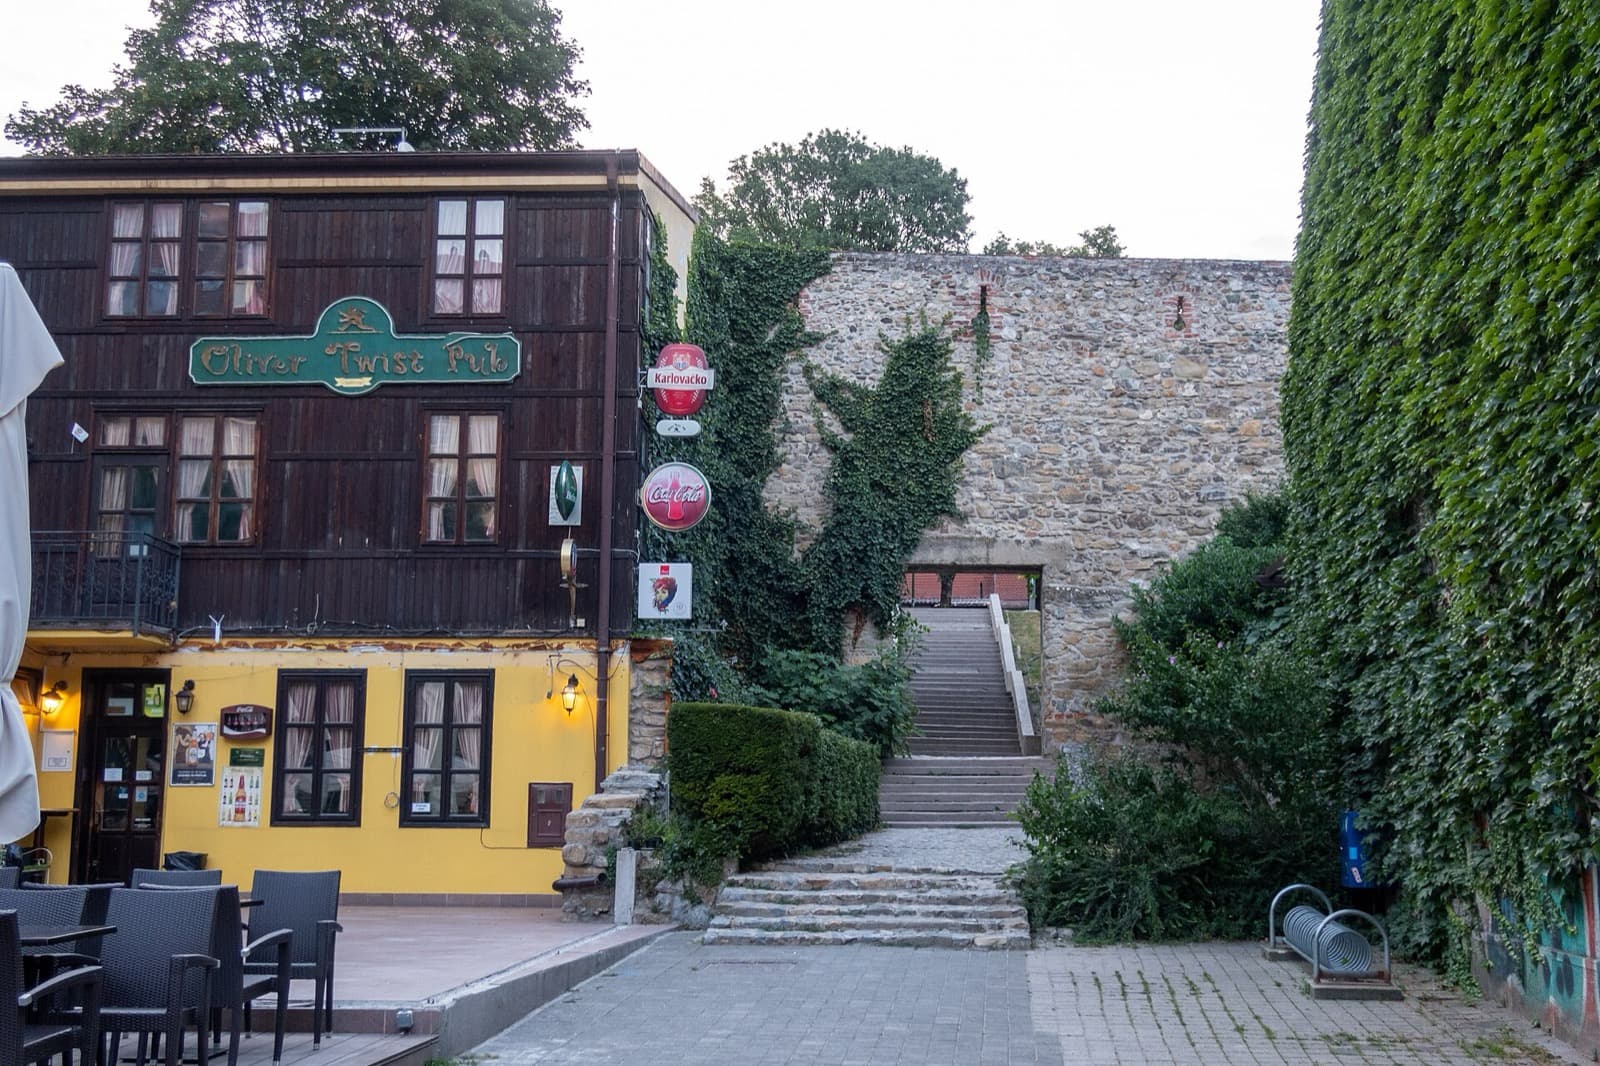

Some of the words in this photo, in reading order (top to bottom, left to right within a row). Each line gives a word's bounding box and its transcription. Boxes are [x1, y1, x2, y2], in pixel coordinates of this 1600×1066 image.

[201, 343, 306, 376] Oliver
[324, 341, 424, 374] Twist
[444, 342, 508, 376] Pub
